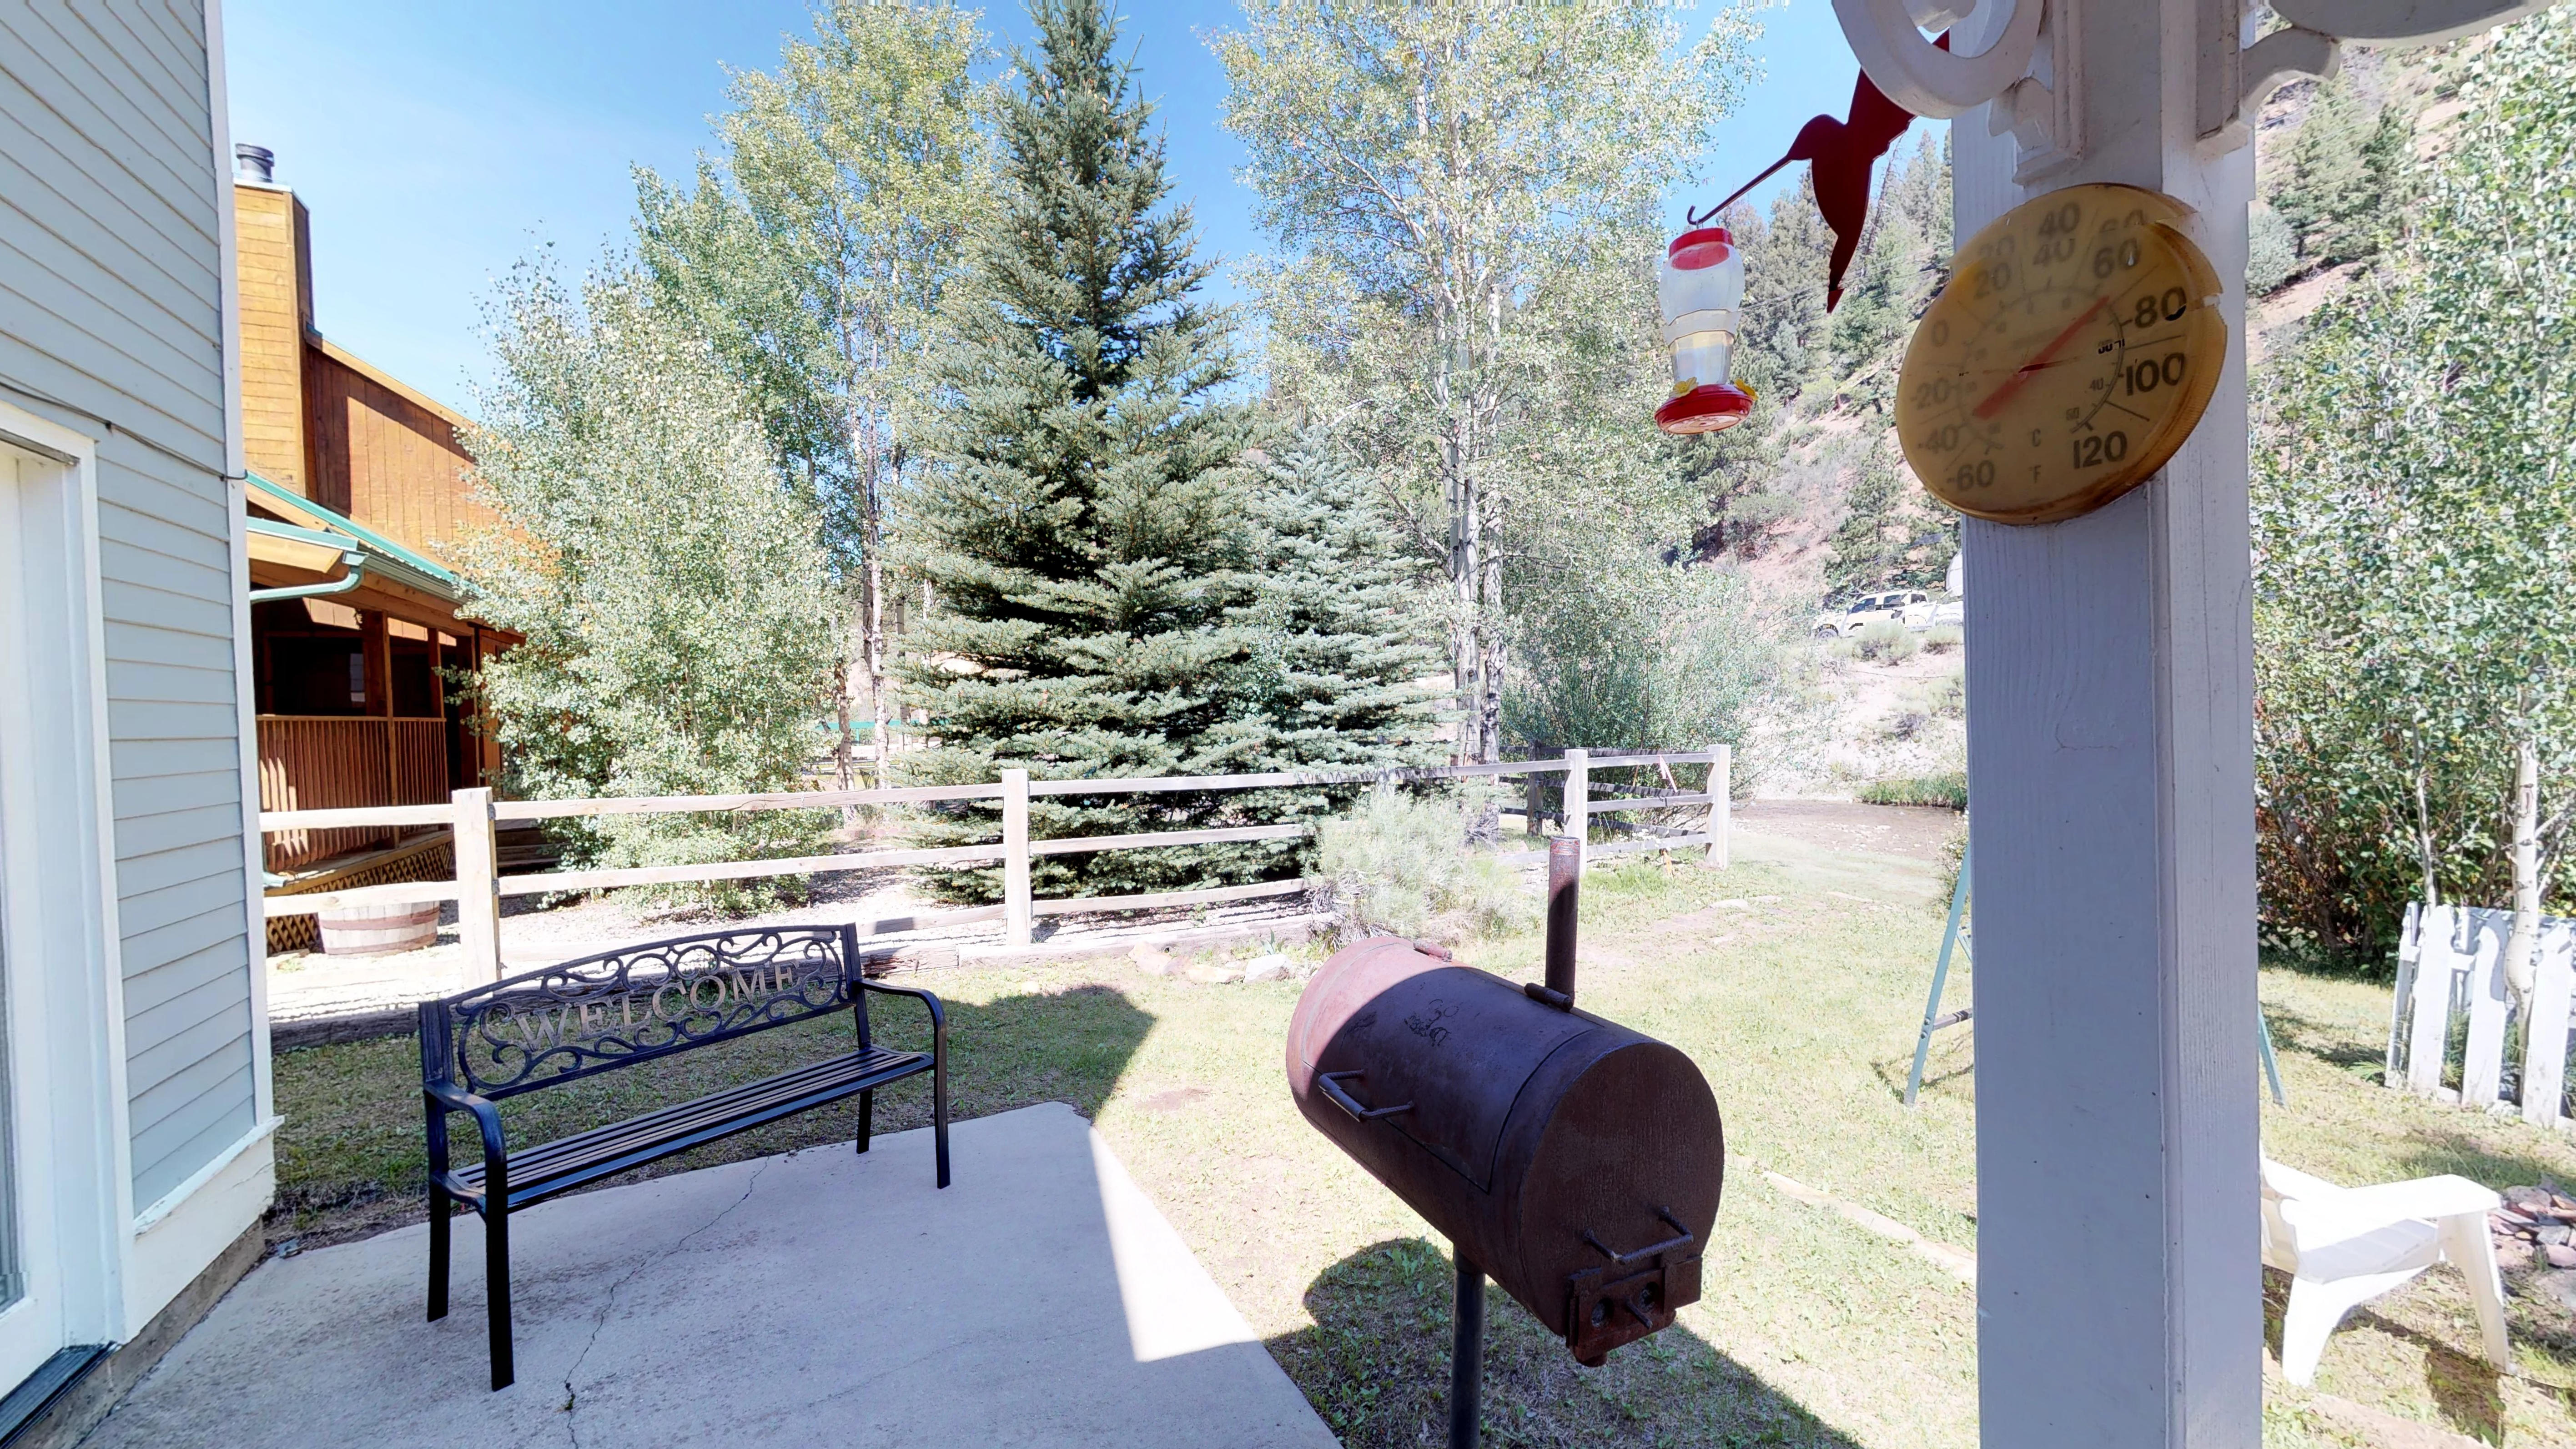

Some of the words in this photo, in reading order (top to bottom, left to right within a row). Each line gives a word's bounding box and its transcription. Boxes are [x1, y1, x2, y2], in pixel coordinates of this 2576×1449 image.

[2093, 237, 2141, 279] 60
[1973, 262, 2011, 300] 20
[2133, 286, 2187, 329] 80
[2125, 352, 2186, 397] 100
[2073, 430, 2128, 469] 120
[511, 958, 804, 1052] WELCOME
